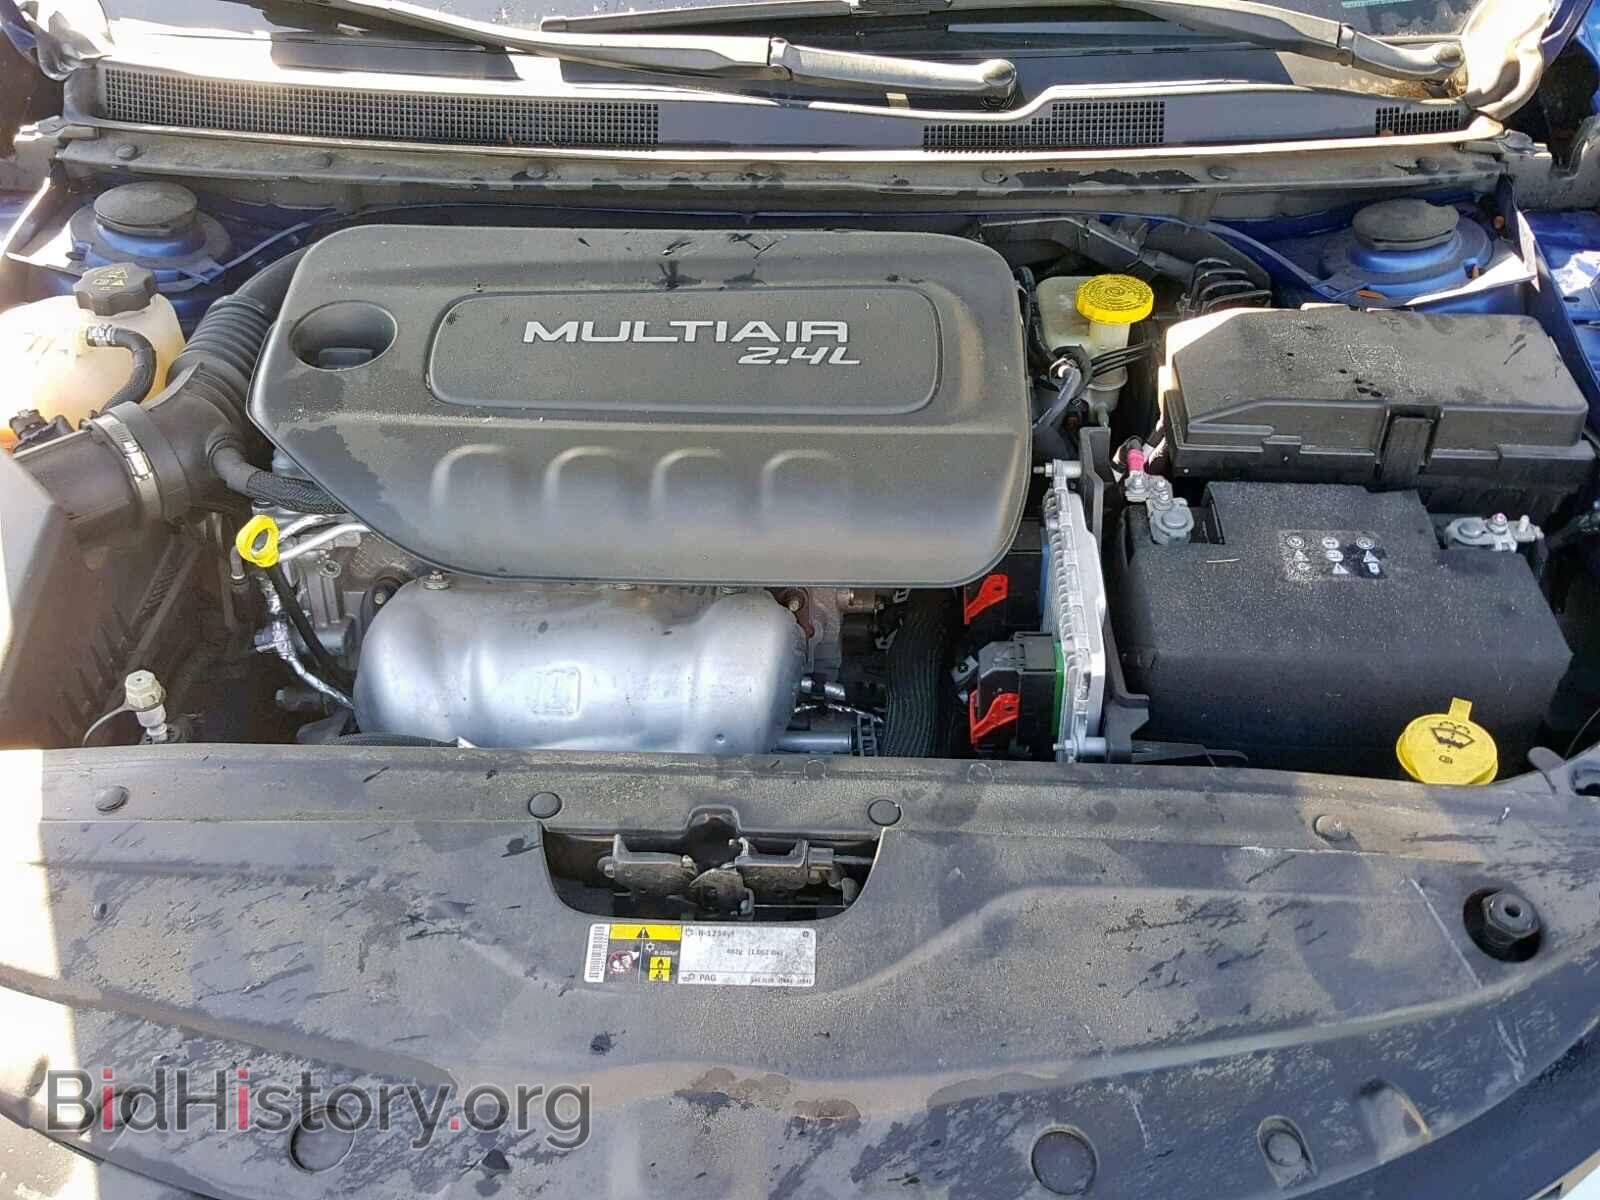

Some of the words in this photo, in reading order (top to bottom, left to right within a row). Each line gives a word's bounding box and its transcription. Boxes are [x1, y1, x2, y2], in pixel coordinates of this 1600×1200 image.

[522, 320, 849, 343] MULTIAIR
[736, 346, 862, 365] 2.4L
[699, 974, 717, 982] PAG
